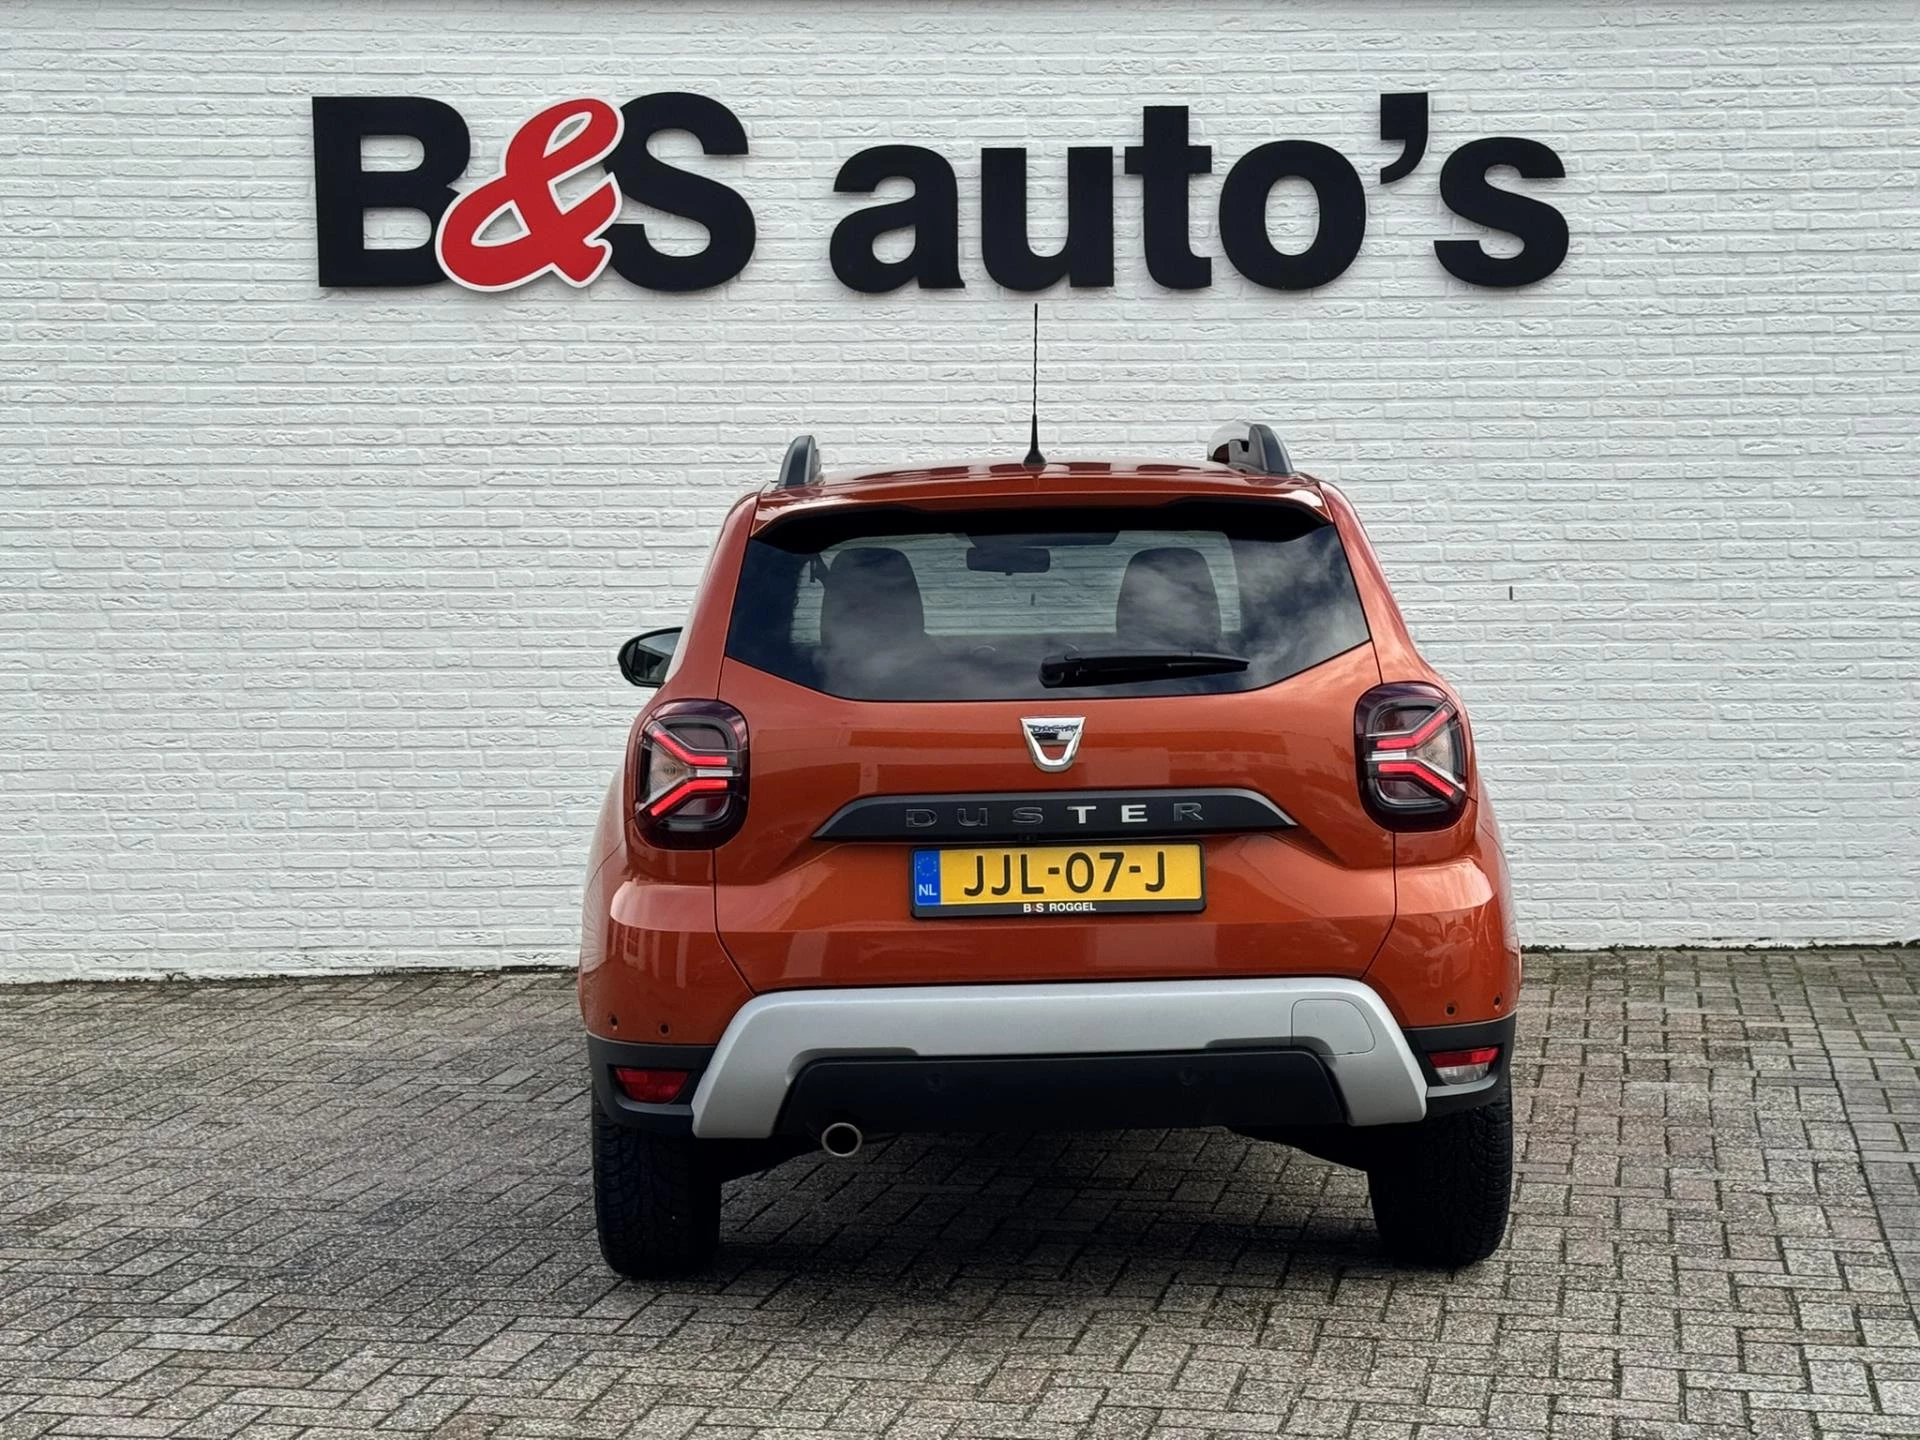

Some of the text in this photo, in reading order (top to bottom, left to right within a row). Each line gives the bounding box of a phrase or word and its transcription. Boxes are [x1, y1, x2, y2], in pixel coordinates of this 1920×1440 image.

[312, 91, 1570, 292] B&S auto's
[905, 803, 1204, 827] DUSTER
[964, 852, 1165, 896] JJL-07-J
[918, 884, 937, 896] NL
[1049, 902, 1096, 911] ROGGEL
